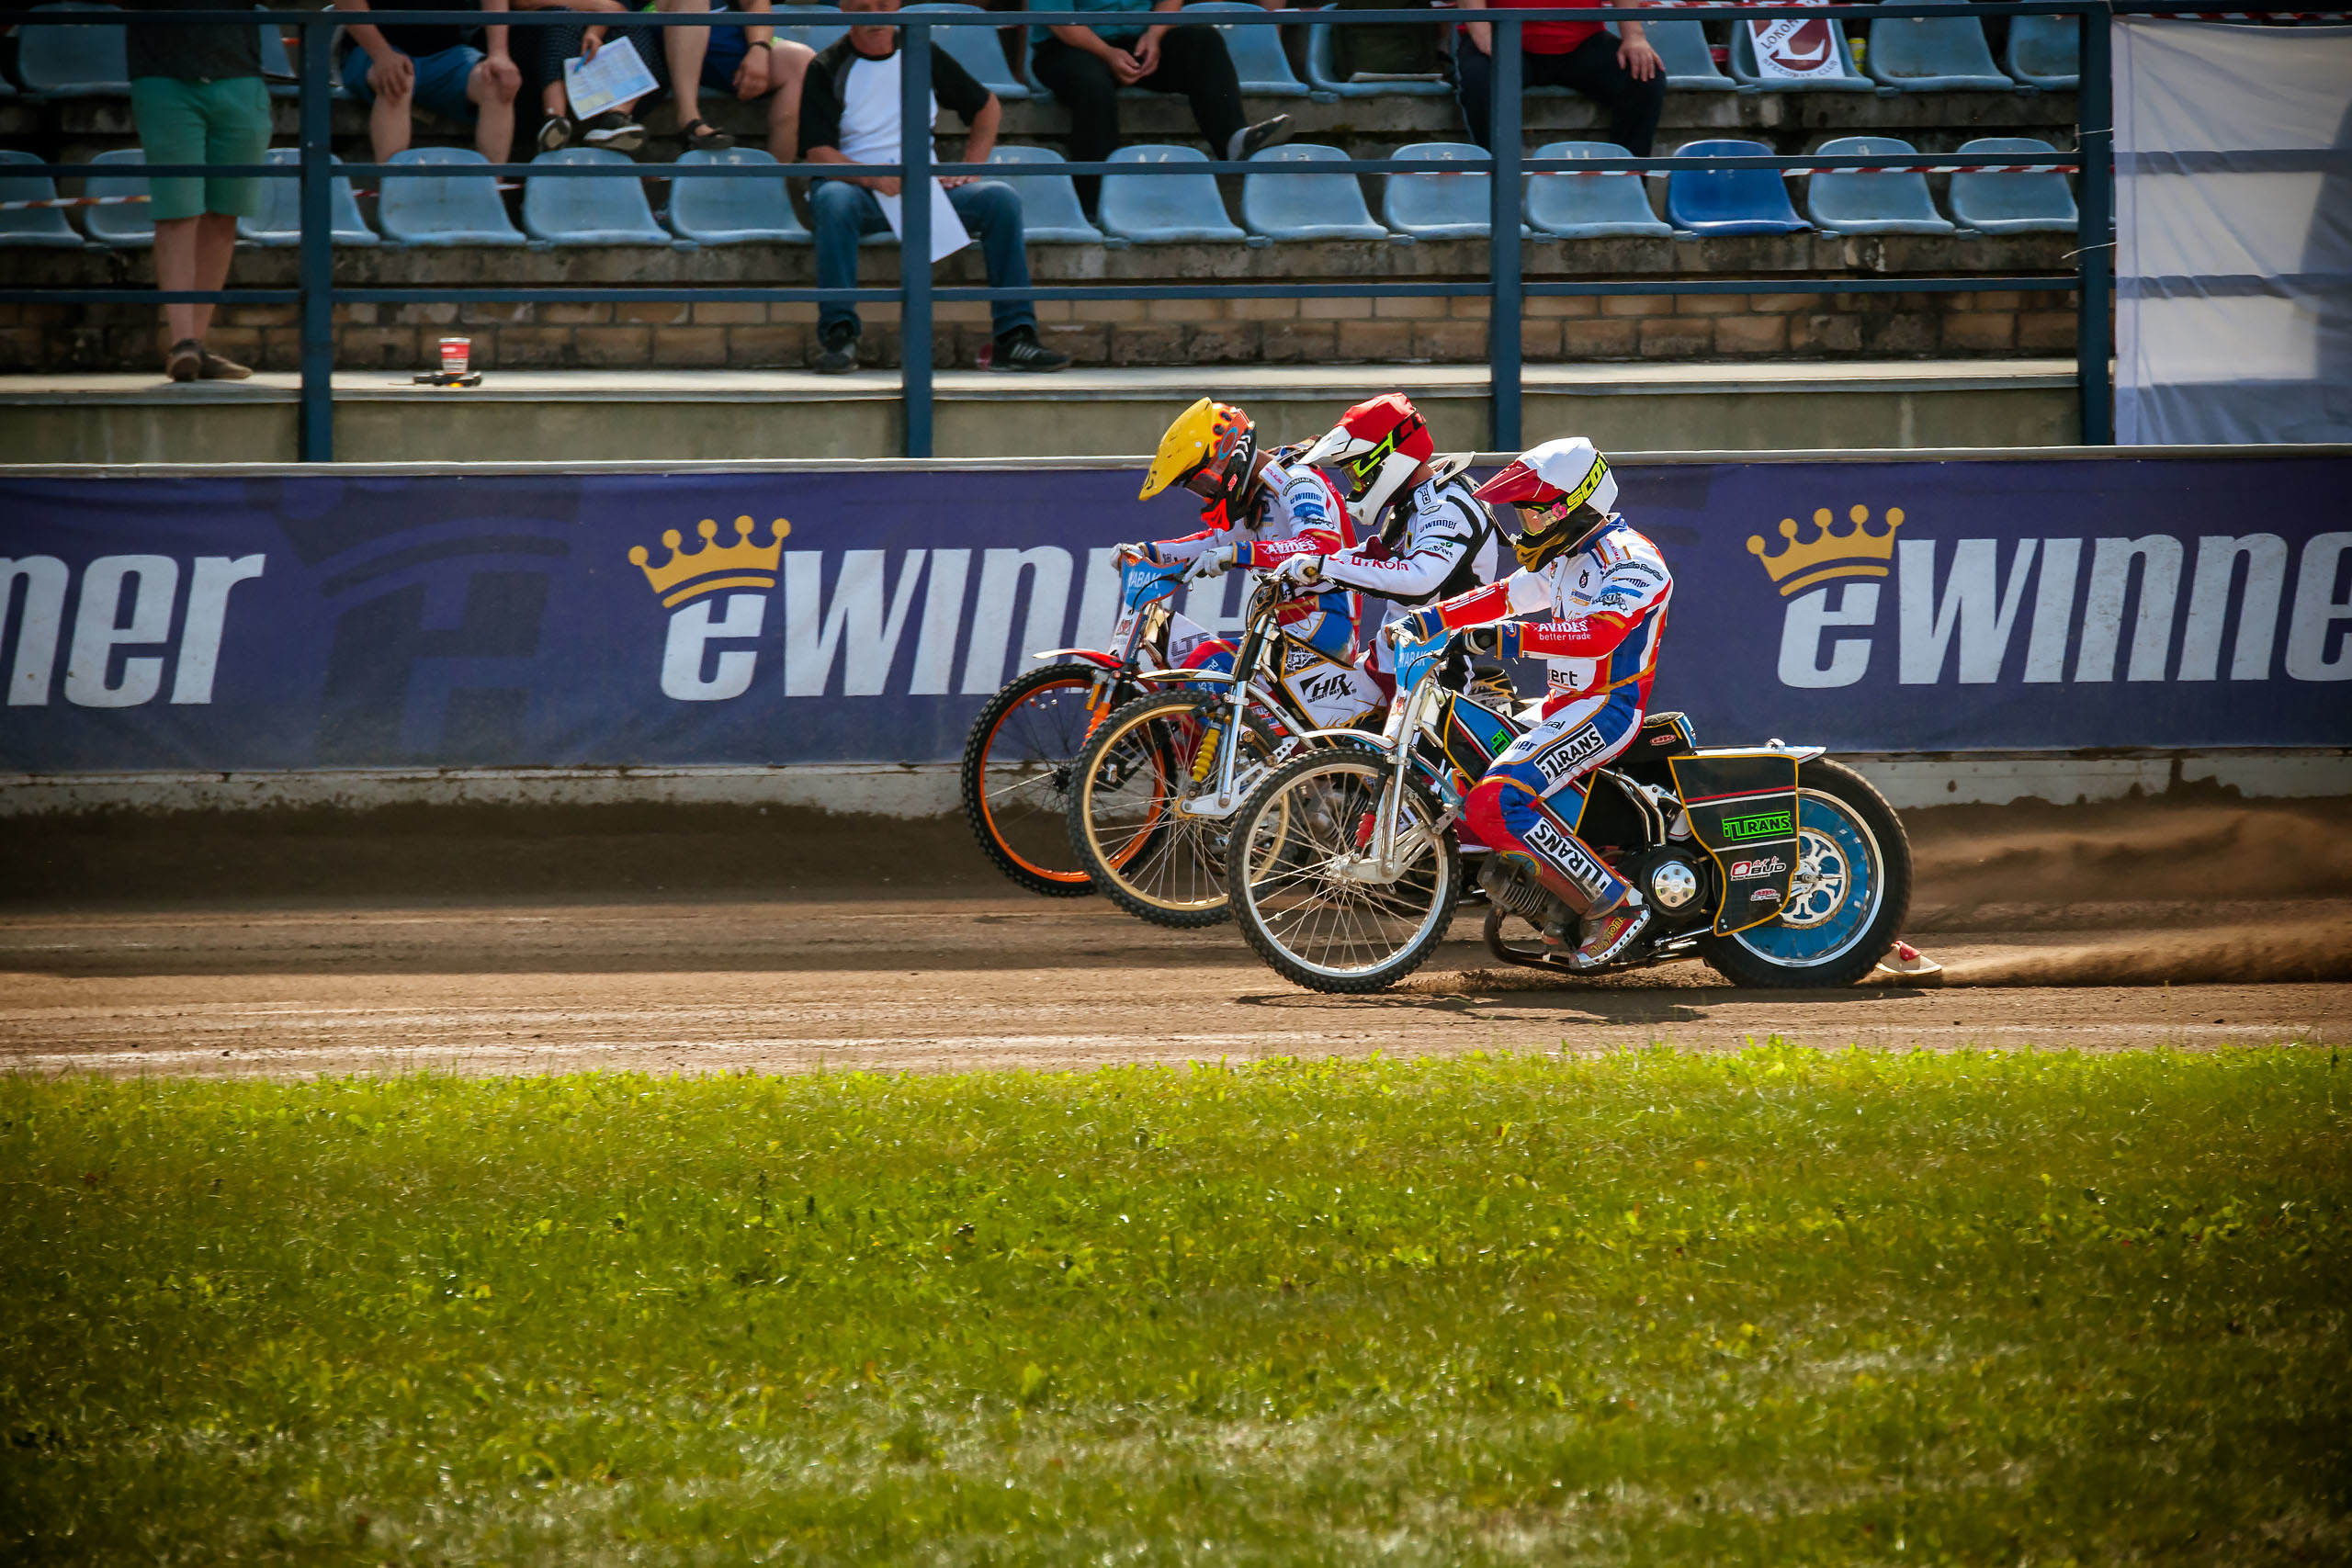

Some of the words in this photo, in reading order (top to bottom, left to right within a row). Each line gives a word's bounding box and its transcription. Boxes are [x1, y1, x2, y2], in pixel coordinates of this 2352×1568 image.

[1537, 621, 1589, 633] AVIDES
[1539, 632, 1566, 641] better
[1751, 863, 1785, 874] BUD
